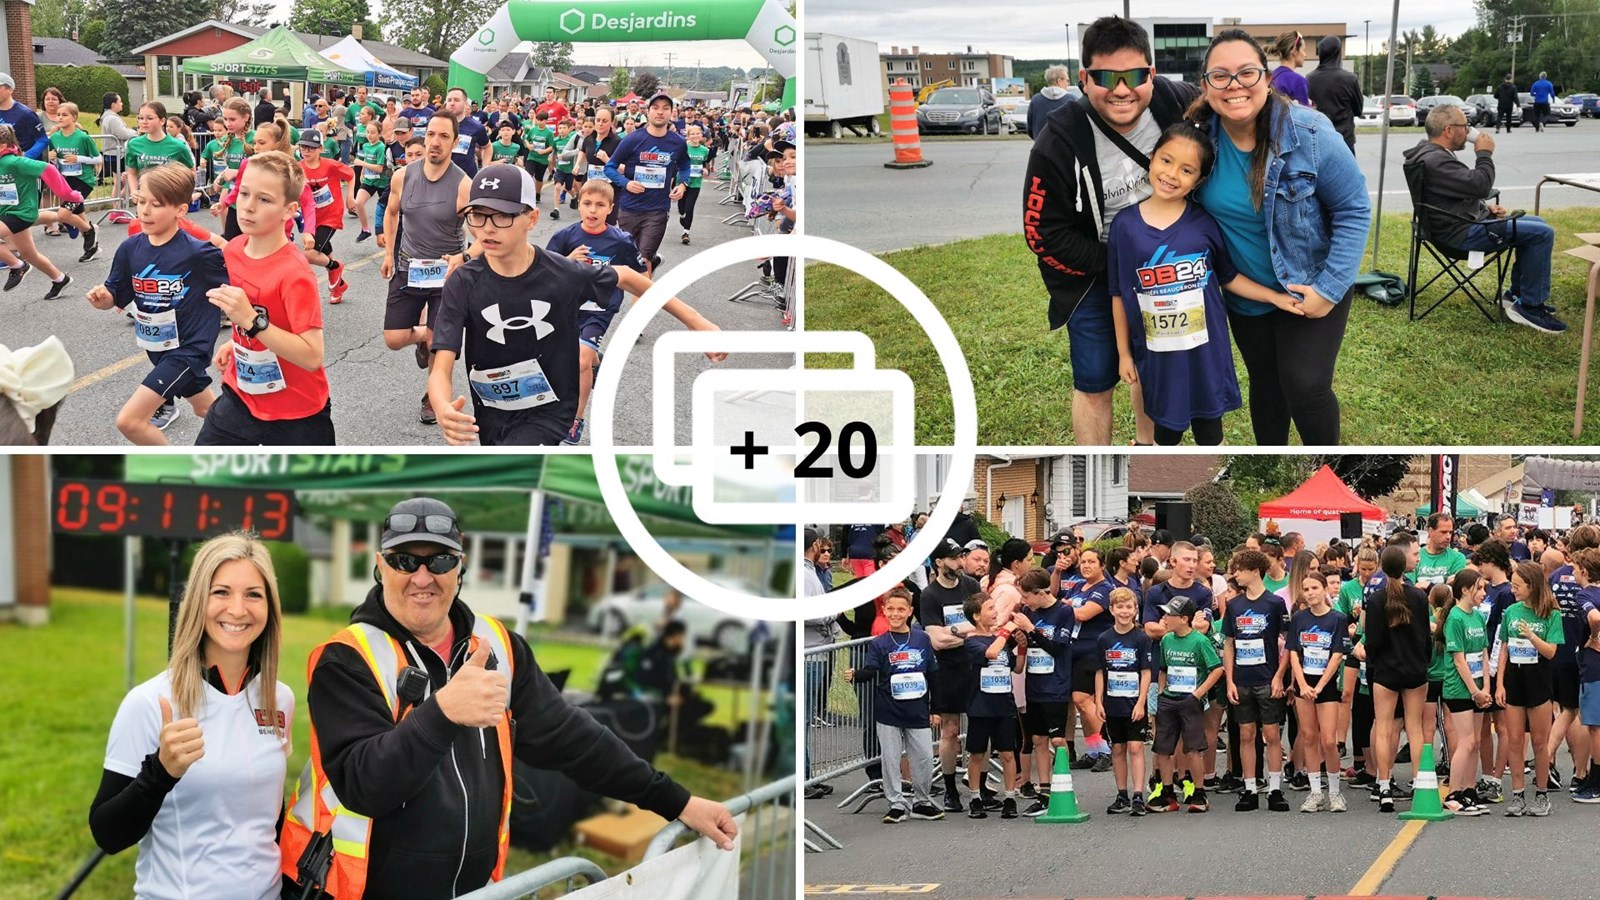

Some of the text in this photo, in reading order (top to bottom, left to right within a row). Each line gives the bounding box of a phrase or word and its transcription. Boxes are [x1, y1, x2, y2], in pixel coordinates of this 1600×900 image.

[591, 11, 697, 33] Desjardins
[209, 62, 279, 75] SPORTSTATS
[1103, 175, 1147, 201] alvin Klein
[420, 266, 442, 276] 1050
[1136, 257, 1207, 289] DB24
[132, 275, 184, 295] DB24
[1159, 282, 1197, 295] BEAUCERON
[1150, 312, 1189, 330] 1572
[491, 380, 520, 395] 897
[56, 482, 290, 539] 09:11:13
